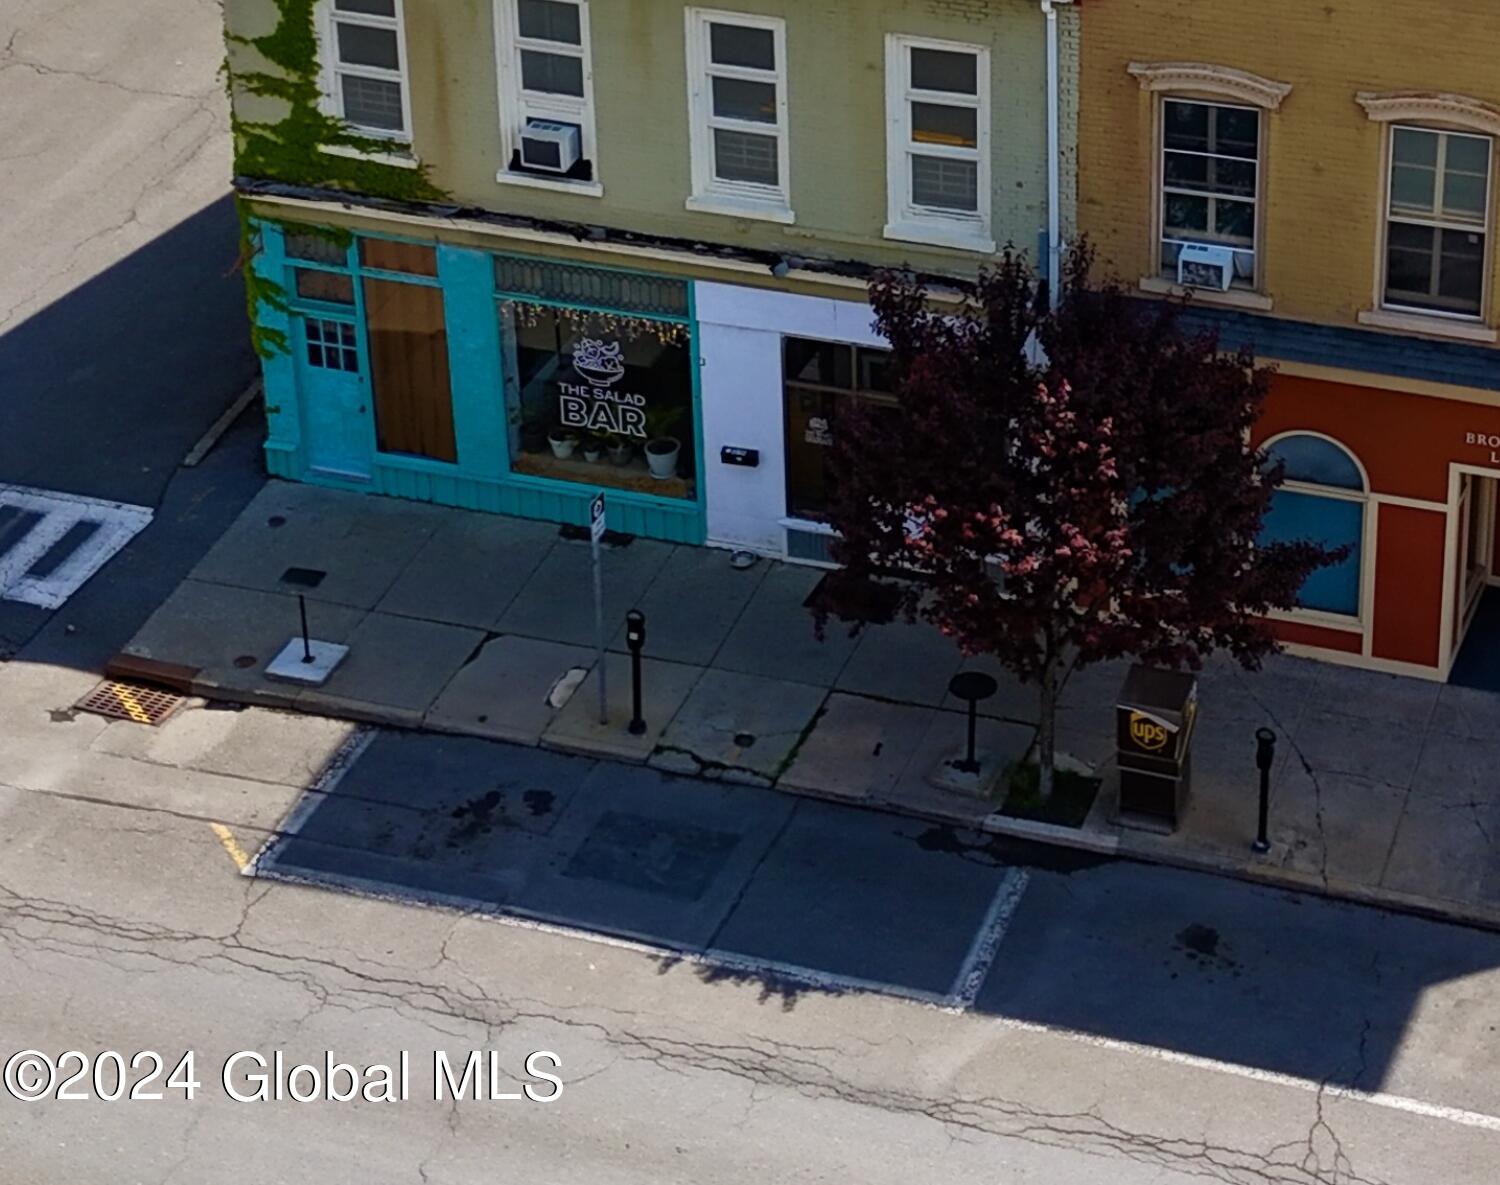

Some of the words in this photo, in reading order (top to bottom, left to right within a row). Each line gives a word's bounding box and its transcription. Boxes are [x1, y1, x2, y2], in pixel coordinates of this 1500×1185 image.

[558, 381, 590, 398] THE
[593, 388, 646, 406] SALAD
[560, 395, 647, 438] BAR
[1133, 721, 1164, 744] ups
